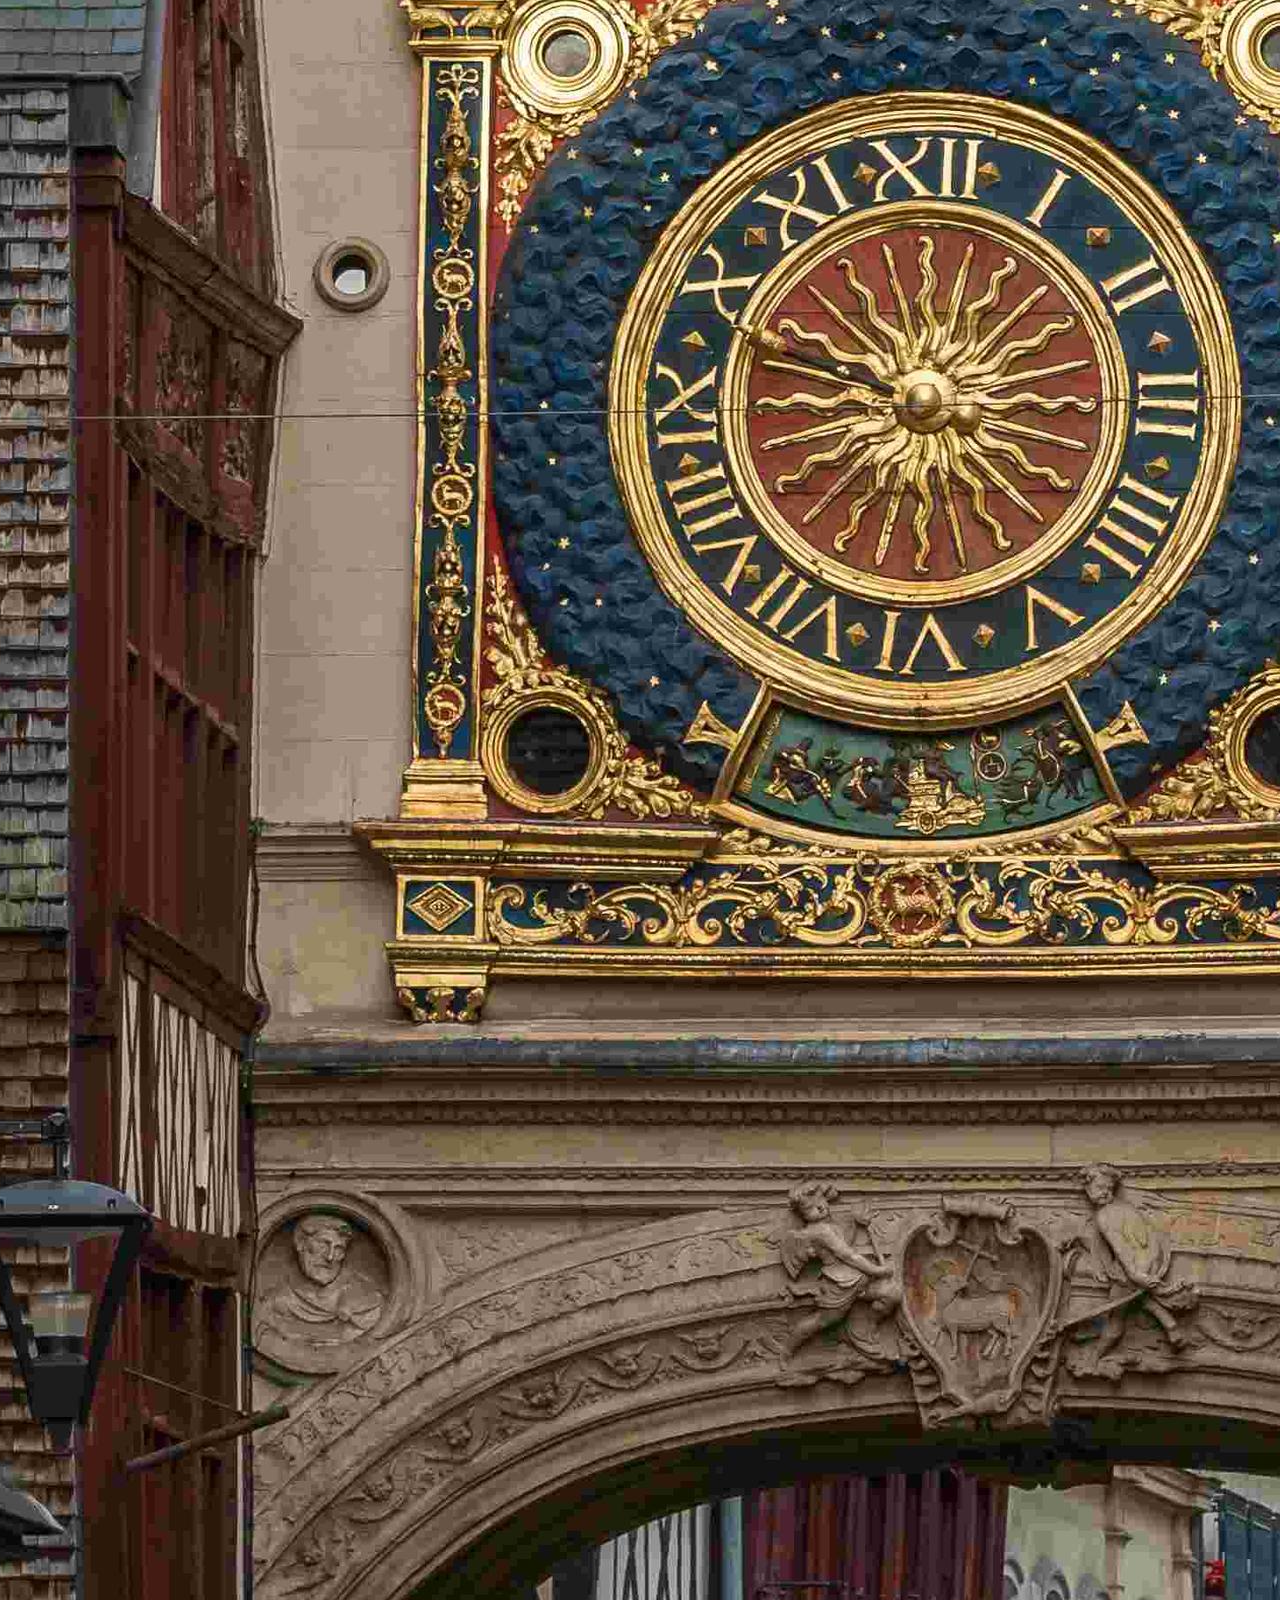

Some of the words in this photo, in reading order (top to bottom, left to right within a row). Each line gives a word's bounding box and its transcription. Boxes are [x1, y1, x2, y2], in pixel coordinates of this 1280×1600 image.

[752, 154, 854, 251] XI
[868, 136, 984, 202] XII
[1025, 168, 1071, 228] I
[678, 243, 762, 326] X
[1100, 254, 1173, 316] II
[654, 361, 718, 448] IX
[1135, 368, 1200, 441] III
[665, 462, 758, 596] VIII
[1083, 472, 1179, 580] IIII
[744, 563, 841, 662] VII
[874, 610, 968, 676] VI
[1025, 585, 1085, 651] V
